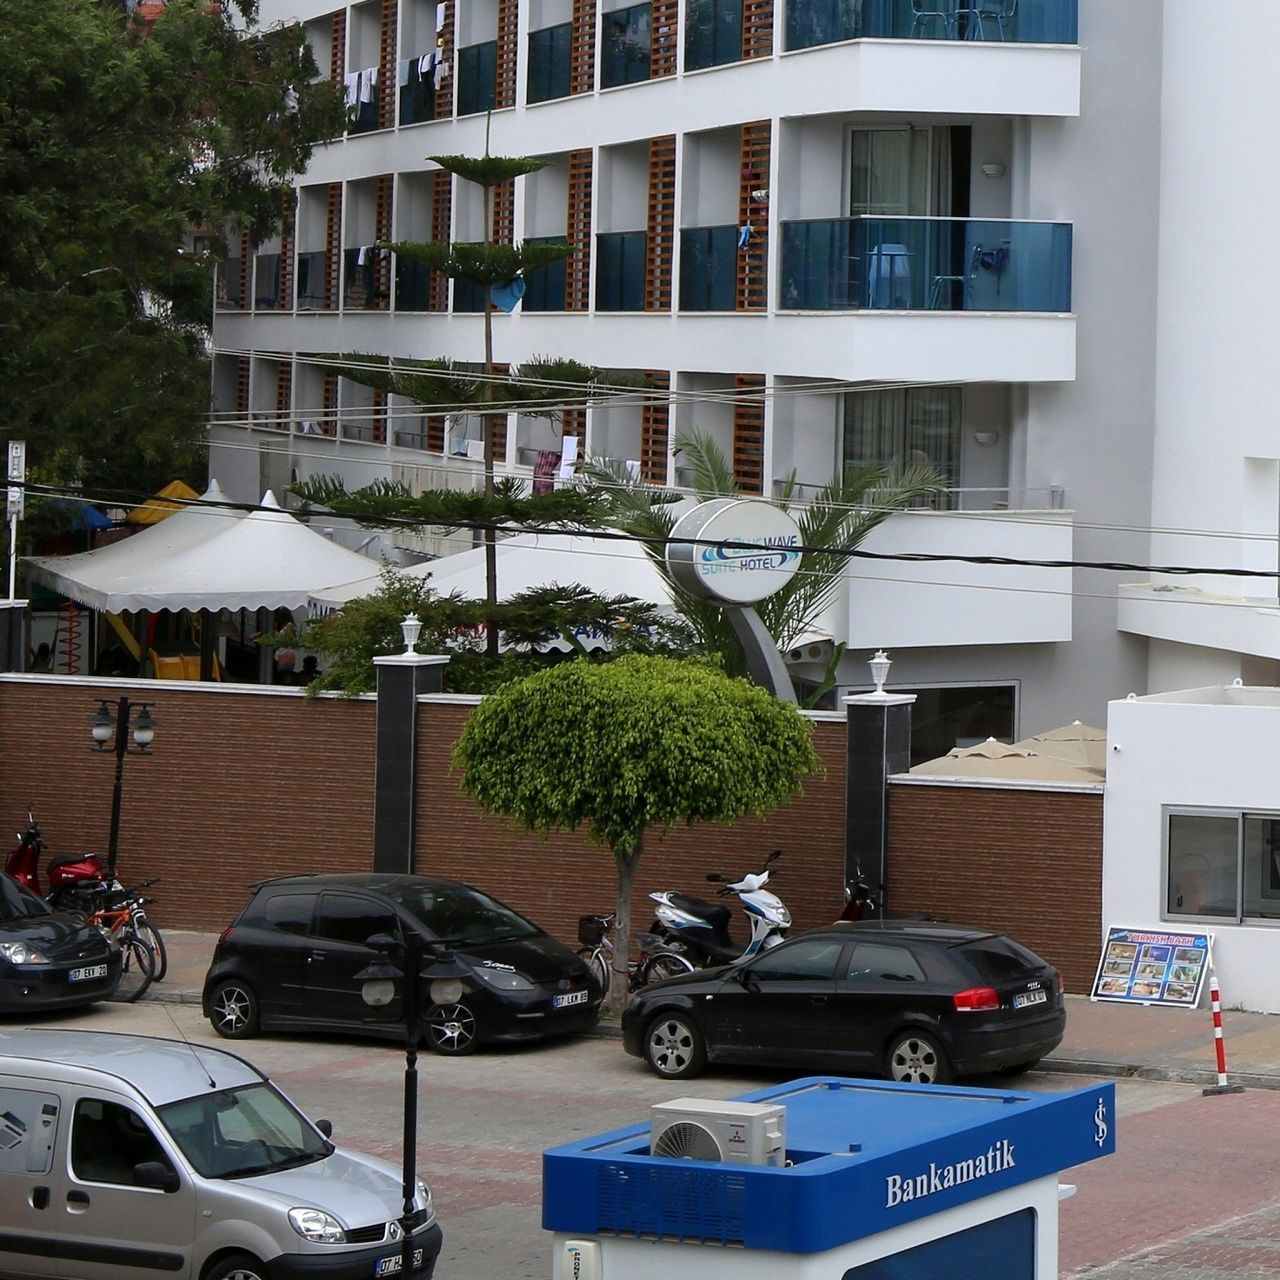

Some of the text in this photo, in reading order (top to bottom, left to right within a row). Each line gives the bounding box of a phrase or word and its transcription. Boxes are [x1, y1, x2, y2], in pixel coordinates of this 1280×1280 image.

[740, 558, 776, 571] HOTEL
[1127, 931, 1167, 944] TURKISH
[1167, 936, 1195, 947] BATH
[885, 1139, 1016, 1208] Bankamatik
